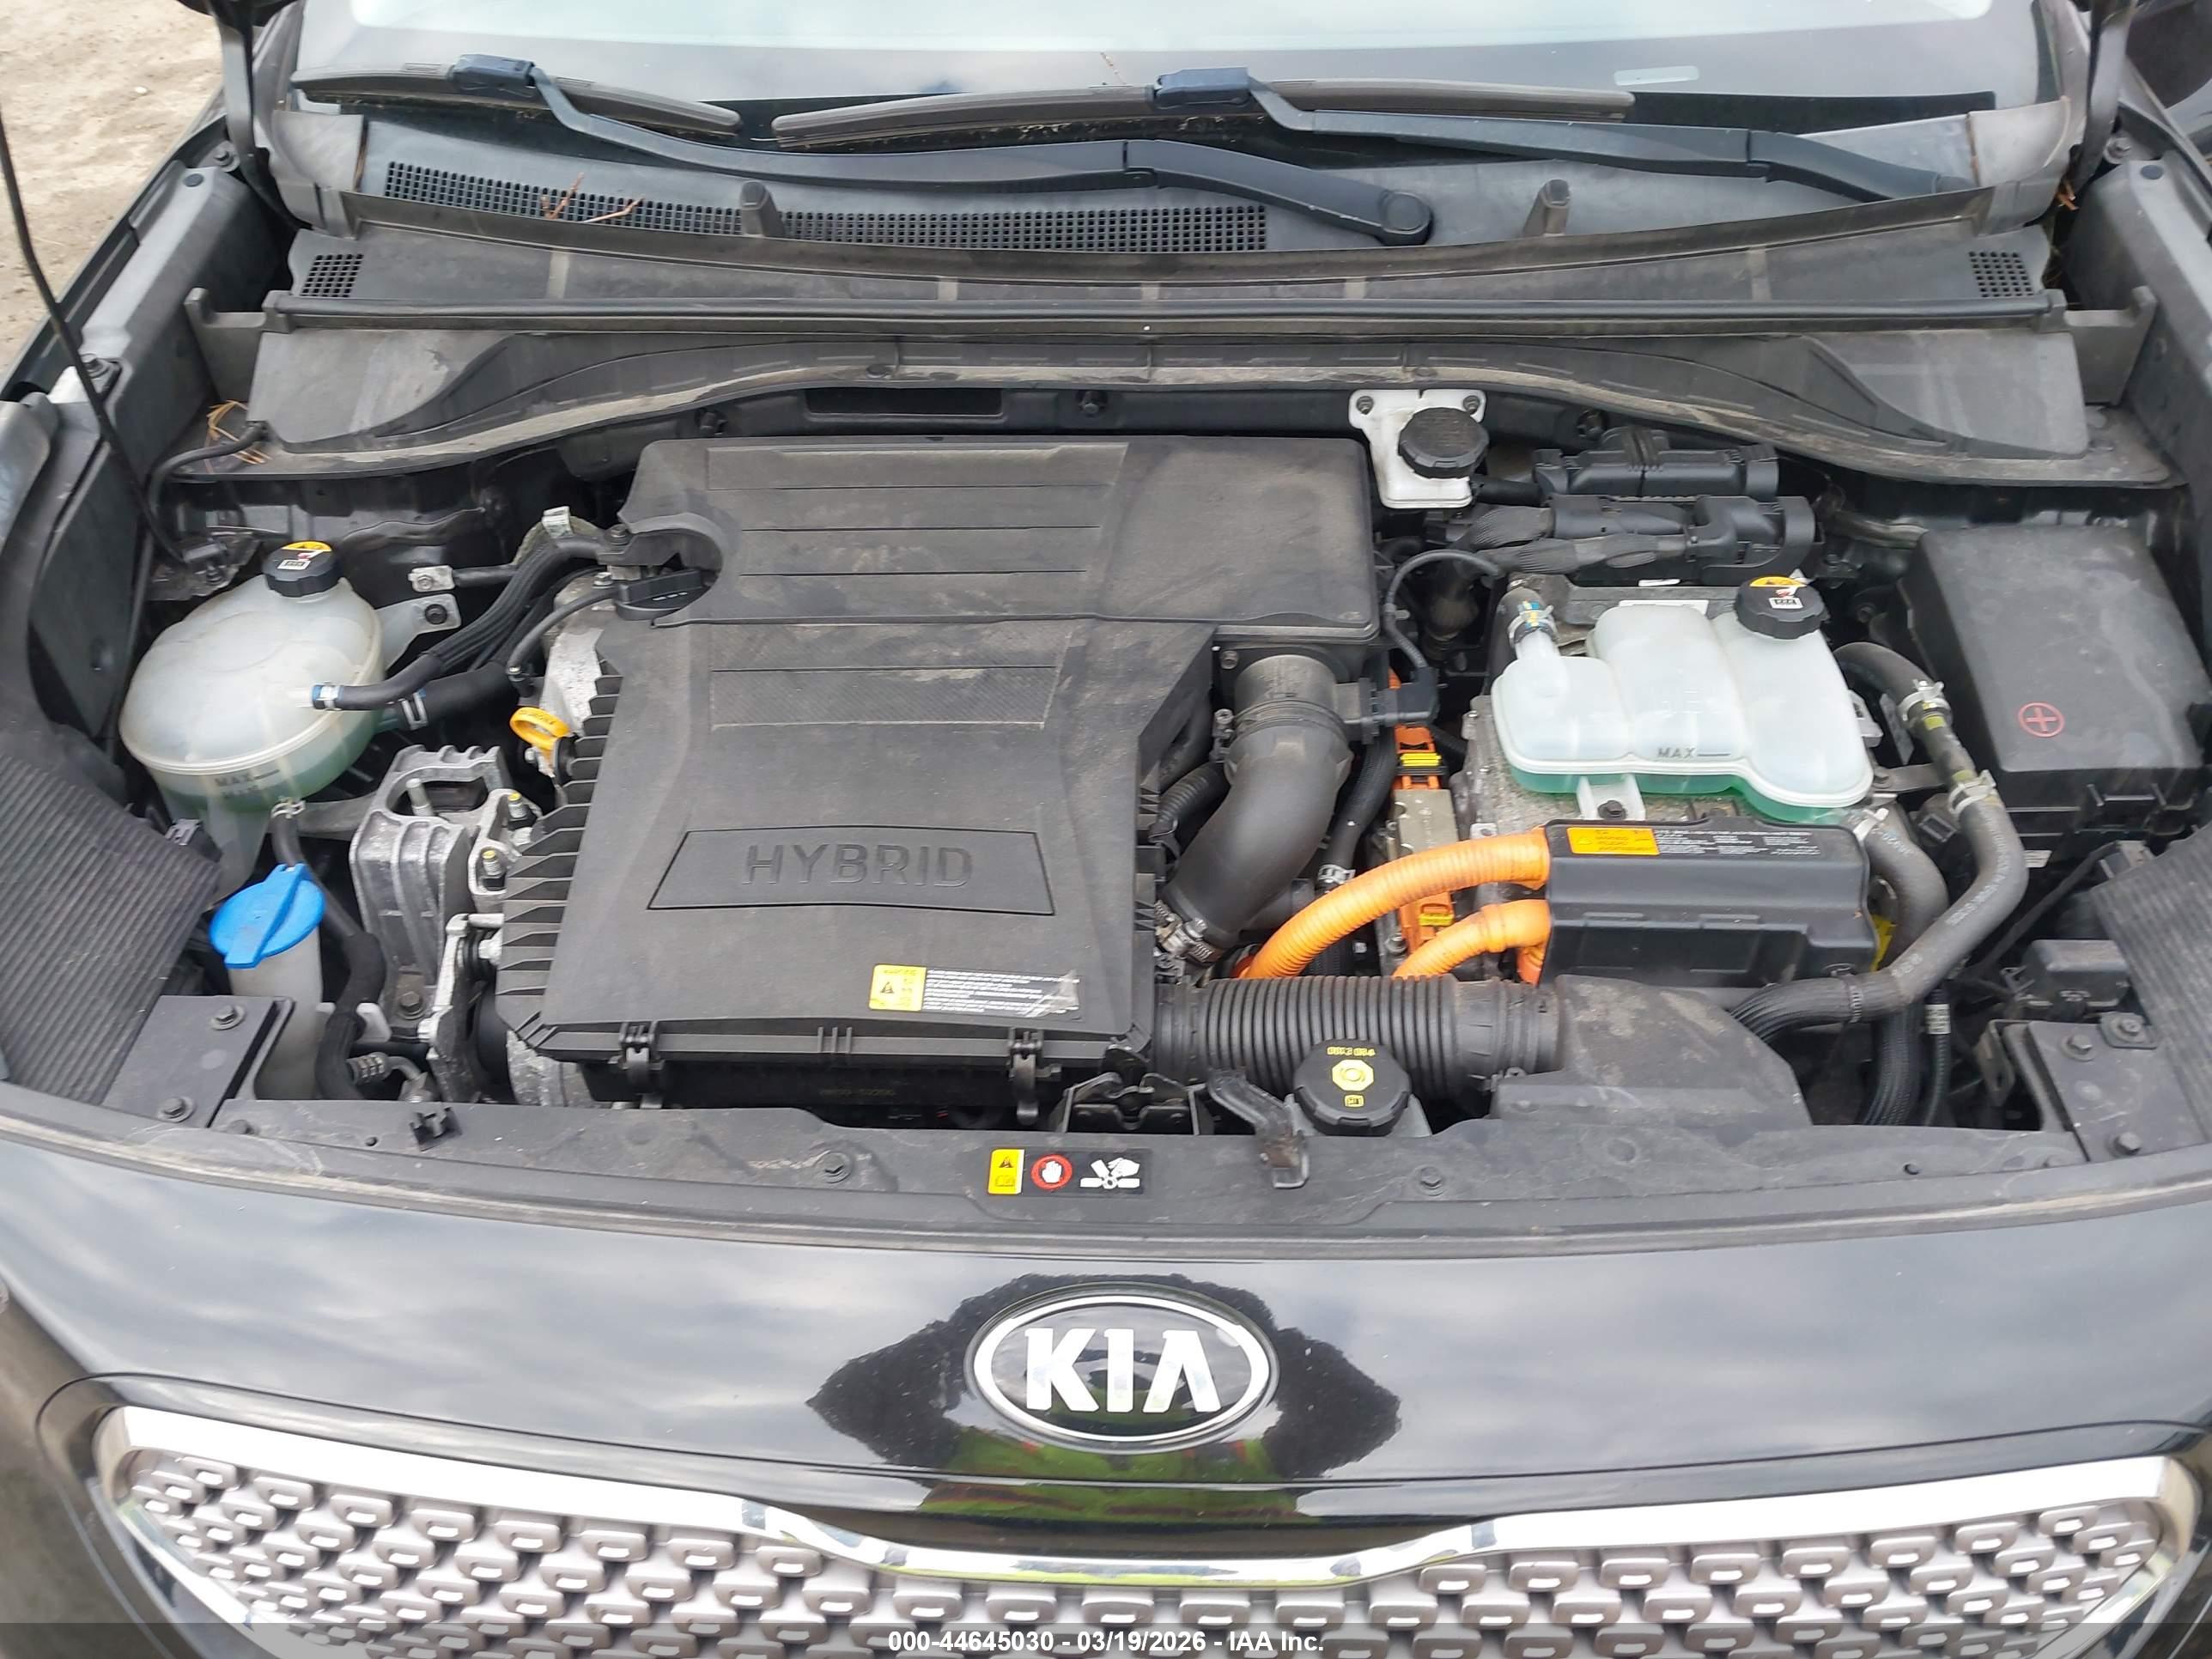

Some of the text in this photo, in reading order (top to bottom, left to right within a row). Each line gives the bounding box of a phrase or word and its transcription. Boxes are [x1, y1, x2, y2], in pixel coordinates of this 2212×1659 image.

[1657, 747, 1696, 758] MAX
[742, 842, 974, 888] HYBRID
[1024, 1328, 1221, 1413] KIA
